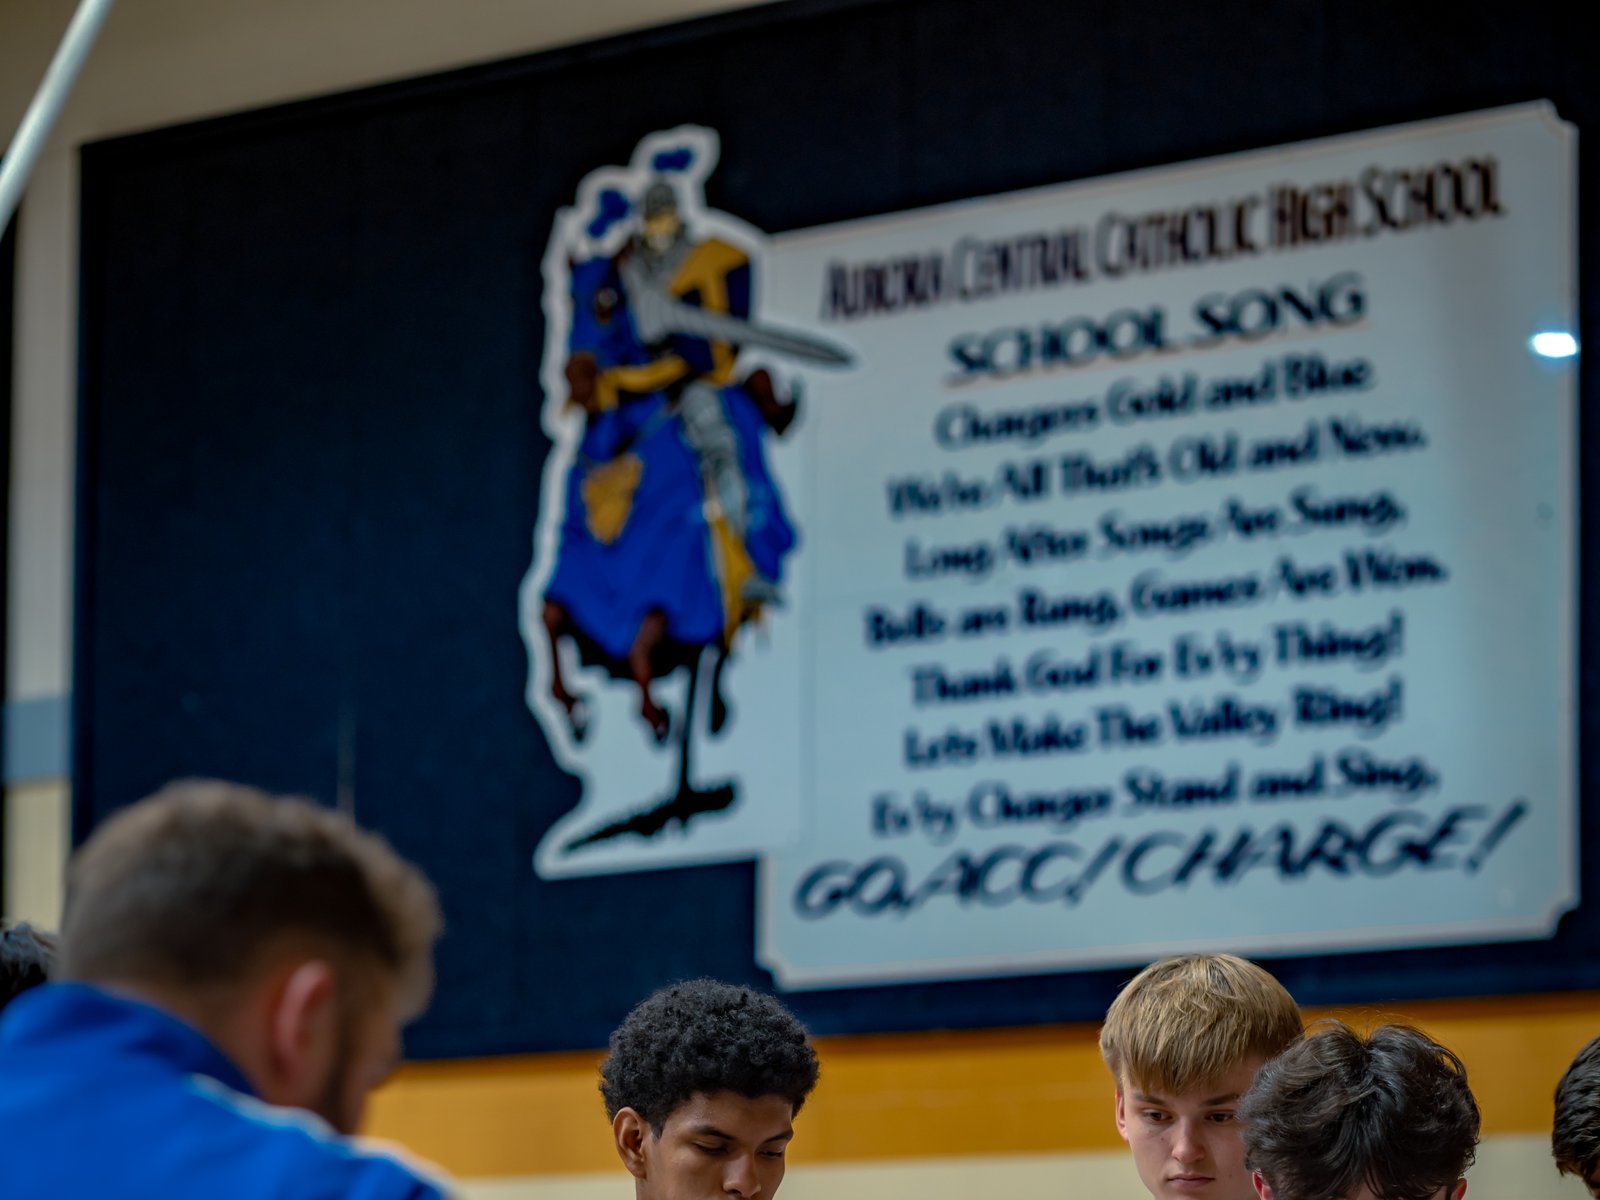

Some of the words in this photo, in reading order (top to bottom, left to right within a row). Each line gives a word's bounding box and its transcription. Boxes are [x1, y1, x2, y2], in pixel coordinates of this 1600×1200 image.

[956, 229, 1089, 296] CENTRAL
[1100, 195, 1256, 275] CATHOLIC
[1269, 184, 1353, 245] HIGH
[1360, 157, 1502, 236] SCHOOL
[947, 307, 1176, 384] SCHOOL
[1186, 274, 1365, 346] SONG
[1109, 373, 1196, 423] Gold
[1207, 361, 1275, 404] and
[1285, 353, 1372, 399] Blue
[998, 462, 1046, 500] All
[1171, 432, 1237, 482] Old
[1251, 420, 1318, 468] and
[908, 539, 992, 581] Long
[1098, 511, 1209, 559] Songs
[1221, 498, 1282, 539] Are
[960, 608, 1008, 633] are
[1132, 570, 1261, 617] Games
[1273, 557, 1335, 599] Are
[912, 658, 1014, 705] Thank
[1027, 645, 1099, 692] God
[1110, 643, 1161, 684] For
[1274, 611, 1401, 670] Thing!
[989, 713, 1085, 758] Make
[1096, 707, 1161, 747] The
[1172, 695, 1280, 743] Valley
[1295, 677, 1401, 737] Ring!
[971, 782, 1111, 832] Charger
[1122, 765, 1239, 813] Stand
[1251, 754, 1323, 798] and
[1123, 801, 1526, 892] CHARGE!
